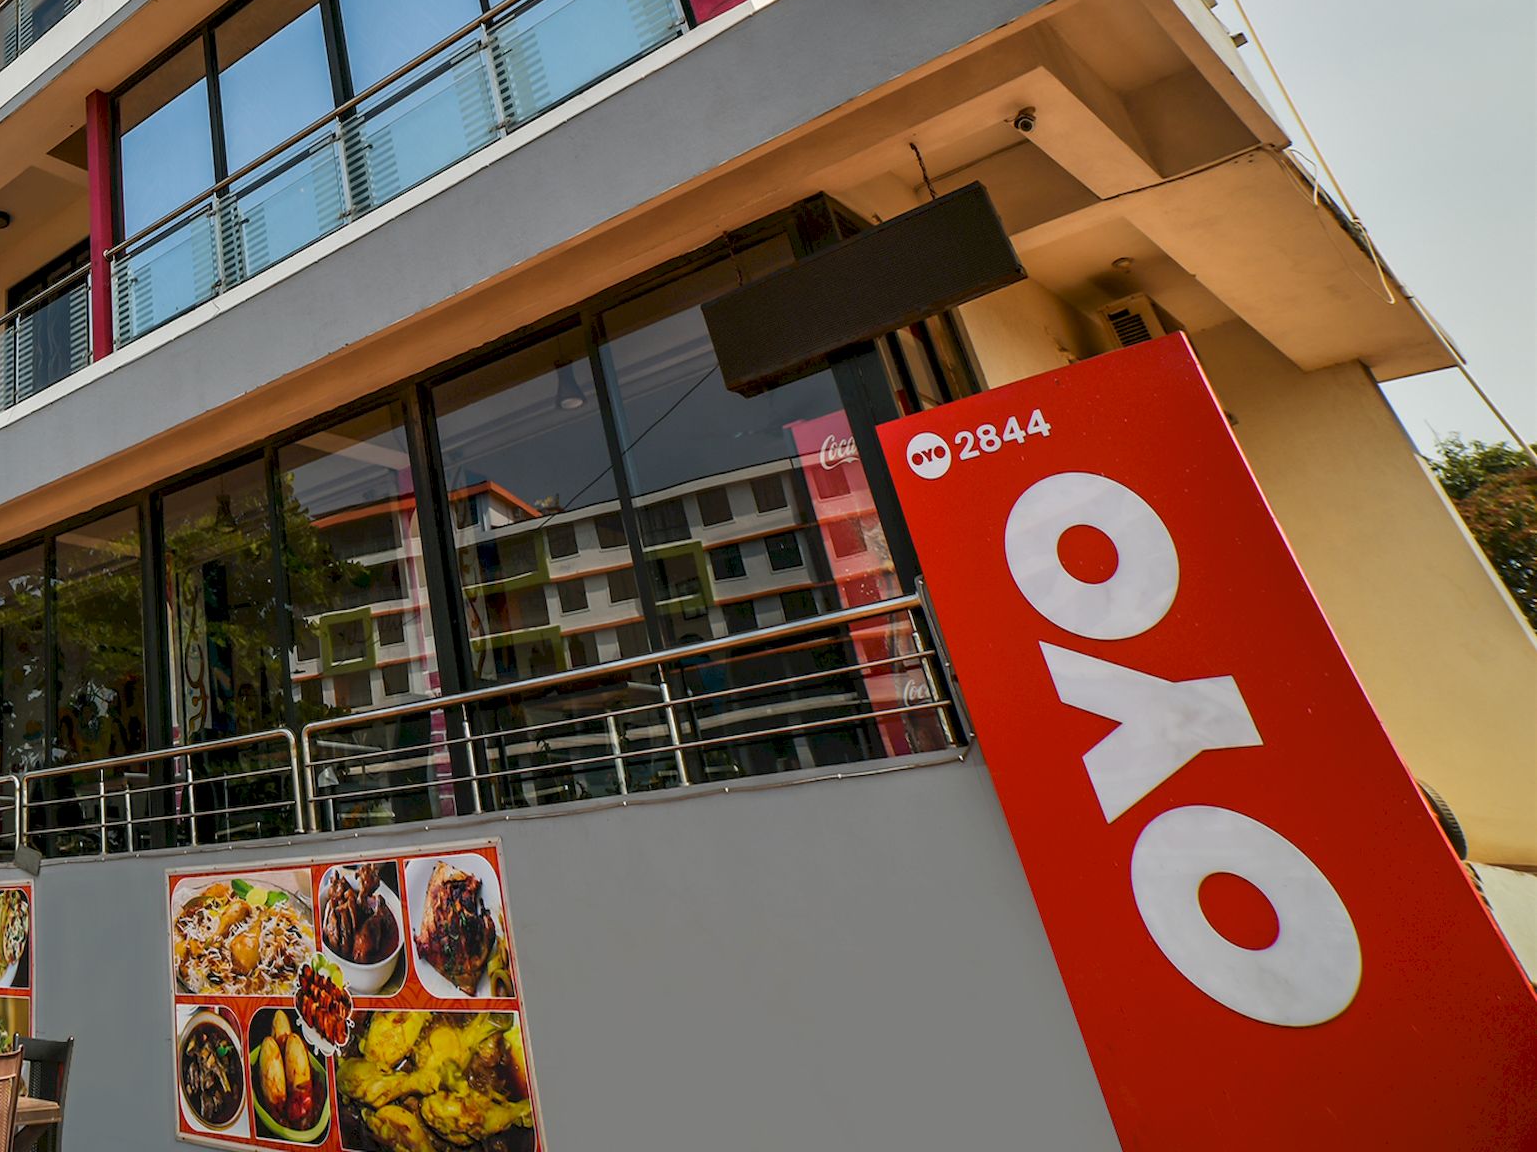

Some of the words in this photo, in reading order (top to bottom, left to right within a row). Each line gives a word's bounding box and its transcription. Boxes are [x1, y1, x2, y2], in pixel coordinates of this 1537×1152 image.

[911, 445, 946, 466] OYO
[954, 408, 1052, 461] 2844
[1004, 472, 1362, 1028] OYO
